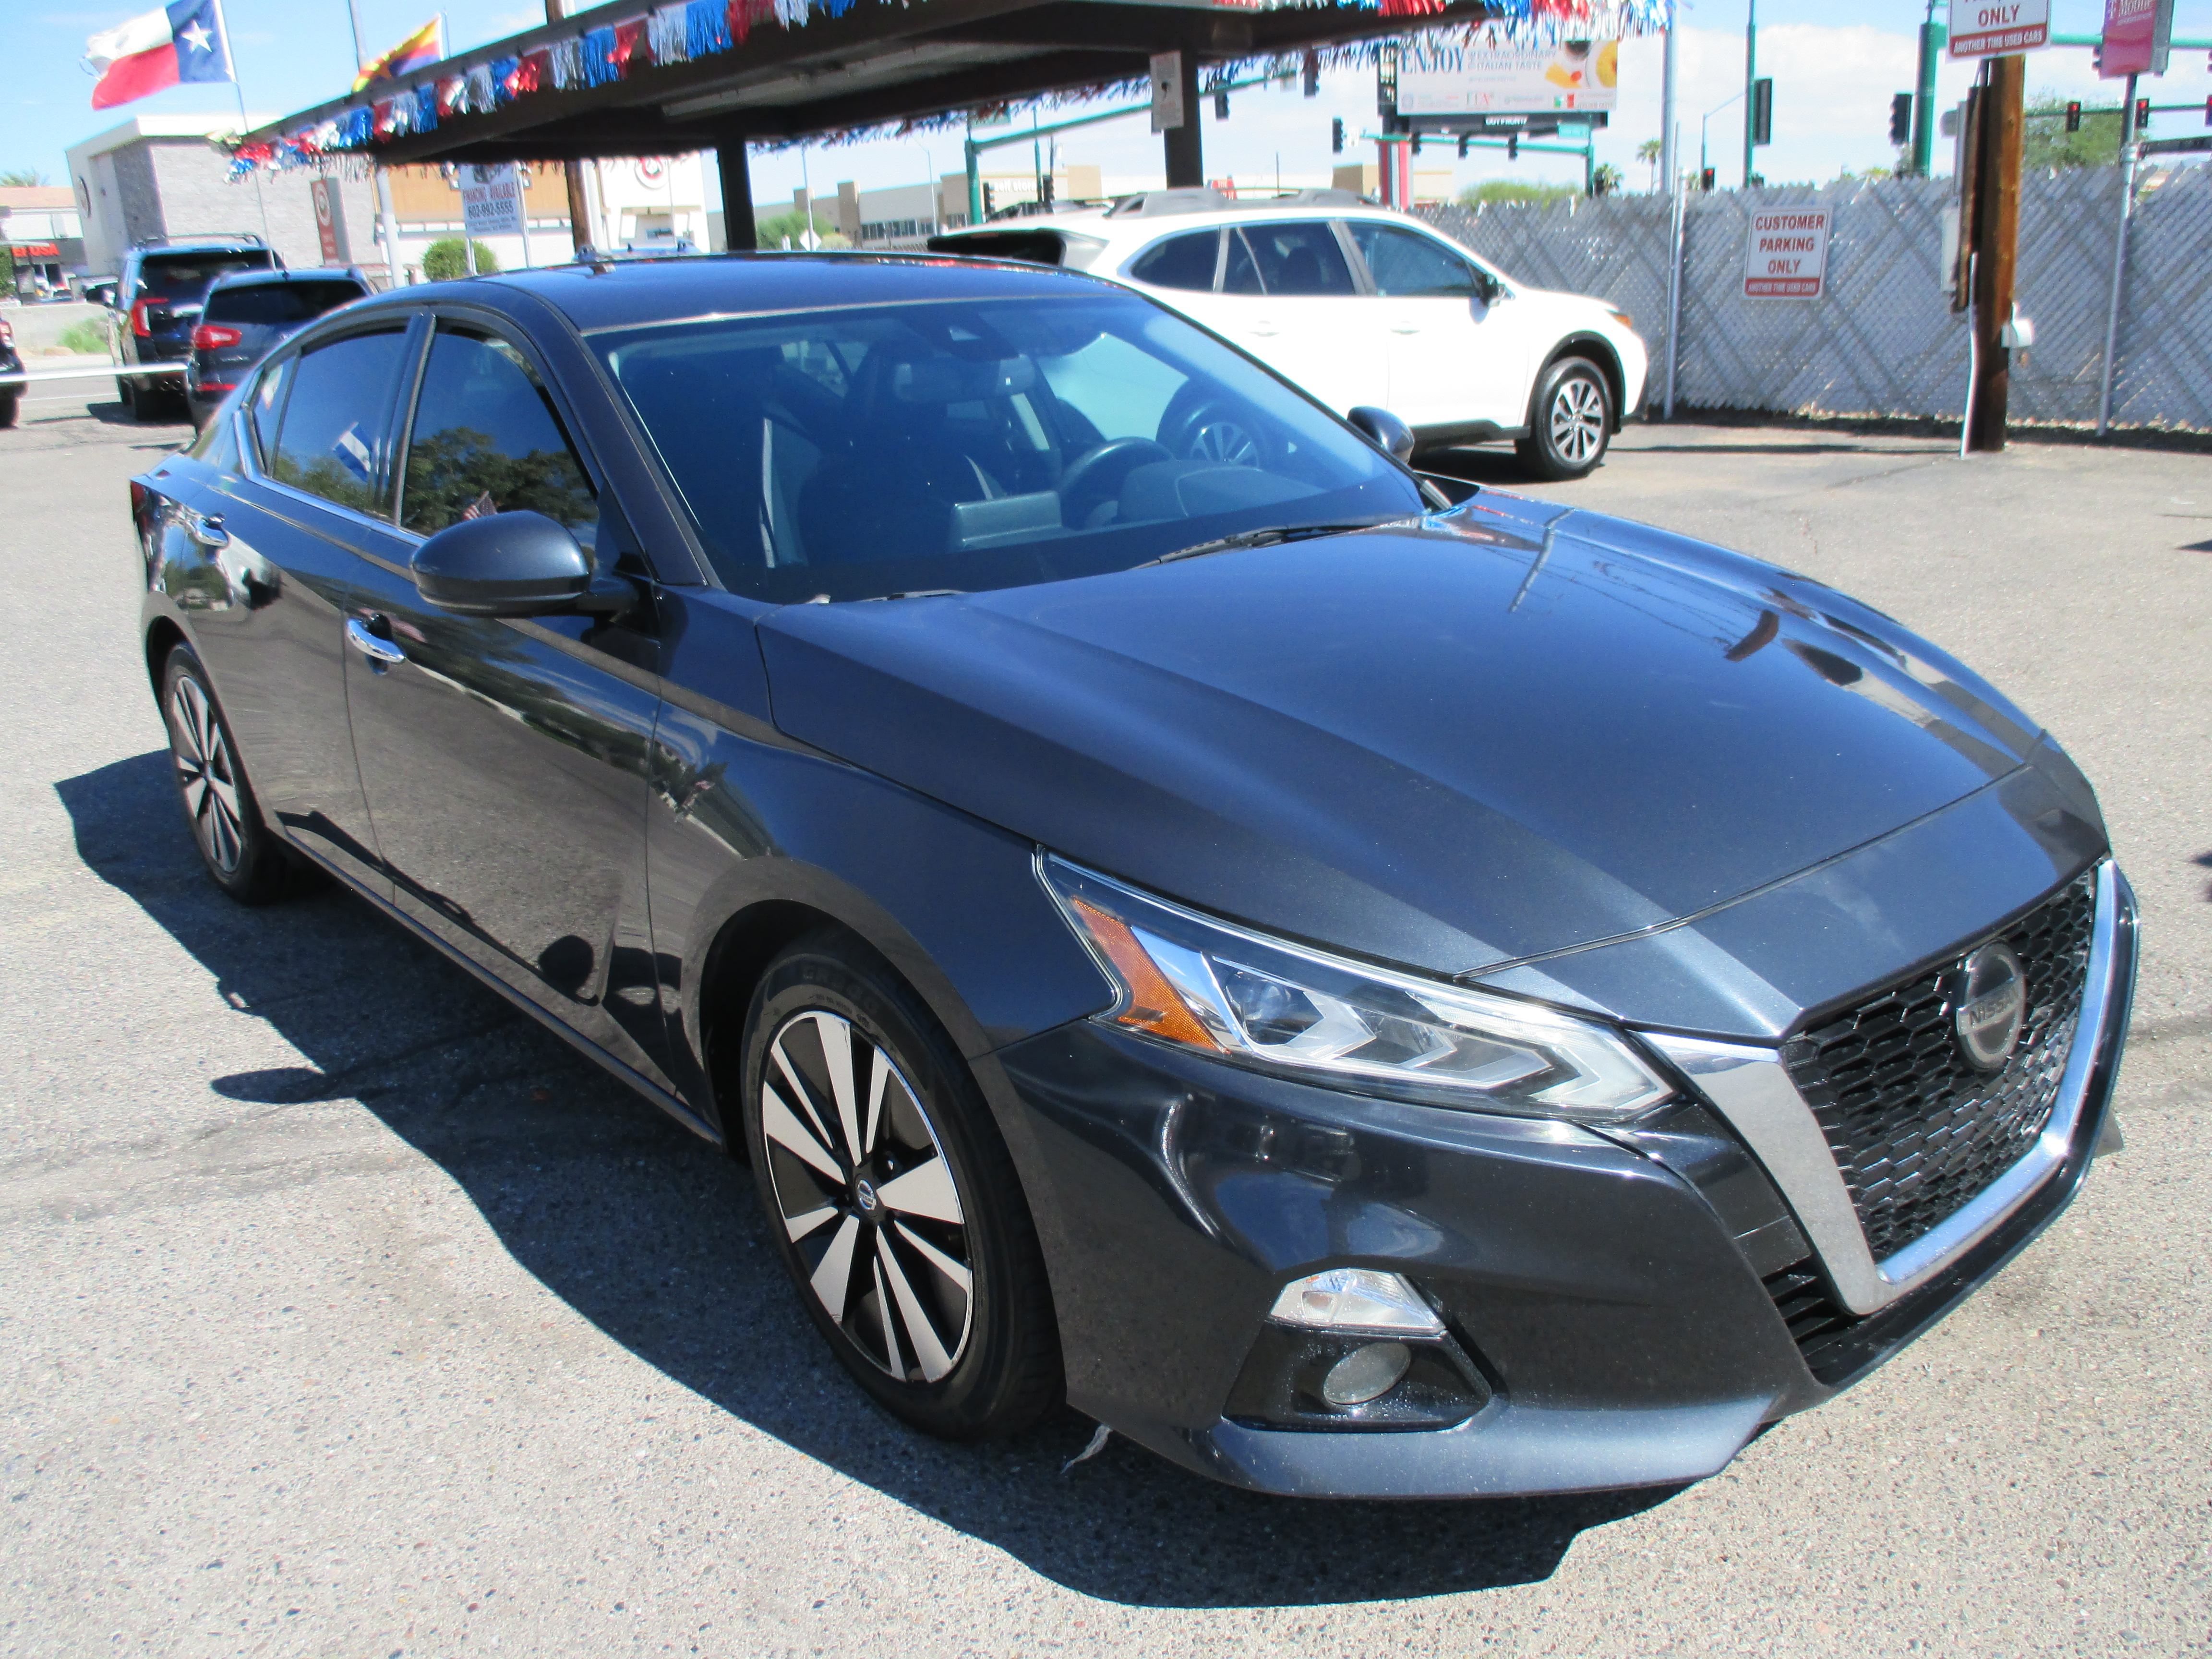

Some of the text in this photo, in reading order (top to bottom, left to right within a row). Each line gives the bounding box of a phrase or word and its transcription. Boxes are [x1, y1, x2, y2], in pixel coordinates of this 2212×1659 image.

[1978, 4, 2020, 26] ONLY
[1953, 29, 2043, 53] ANOTHER TIME USED CARS
[1401, 46, 1464, 73] ENJOY
[1755, 215, 1824, 231] CUSTOMER
[1759, 237, 1815, 252] PARKING
[1768, 259, 1801, 274] ONLY
[1969, 986, 2018, 1027] NISSAN
